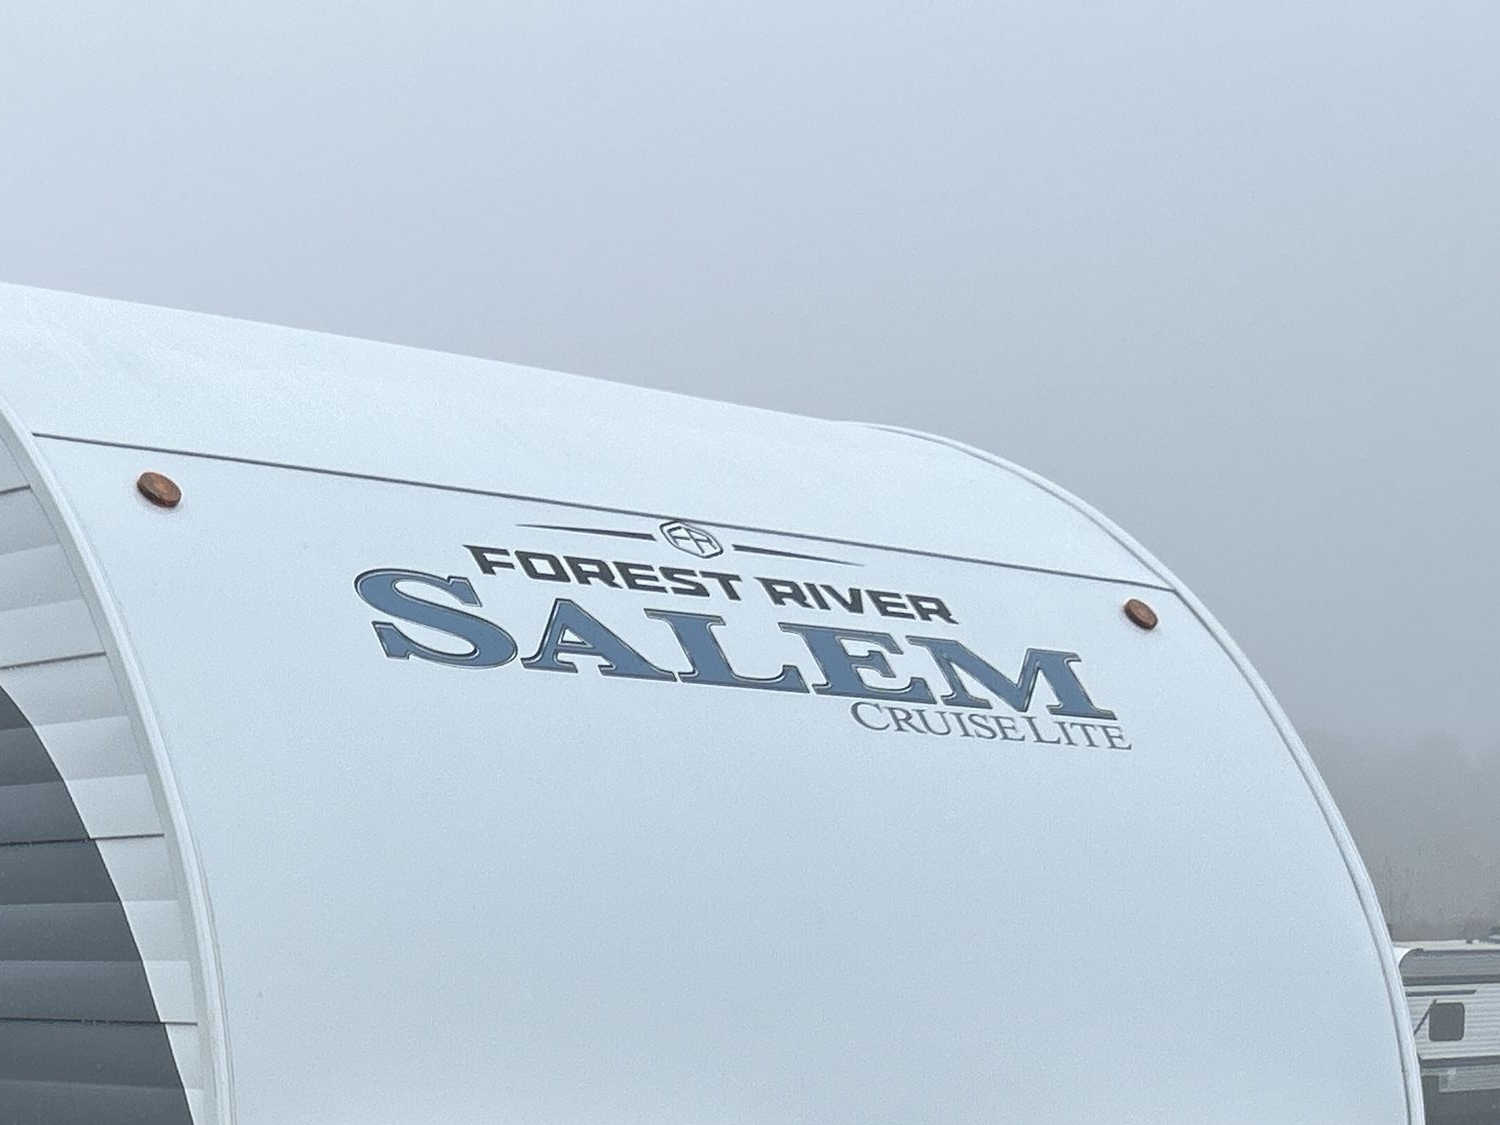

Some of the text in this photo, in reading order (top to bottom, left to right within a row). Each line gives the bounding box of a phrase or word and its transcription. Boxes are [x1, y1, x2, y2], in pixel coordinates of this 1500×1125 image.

[462, 544, 959, 625] FOREST RIVER
[353, 567, 1118, 721] SALEM
